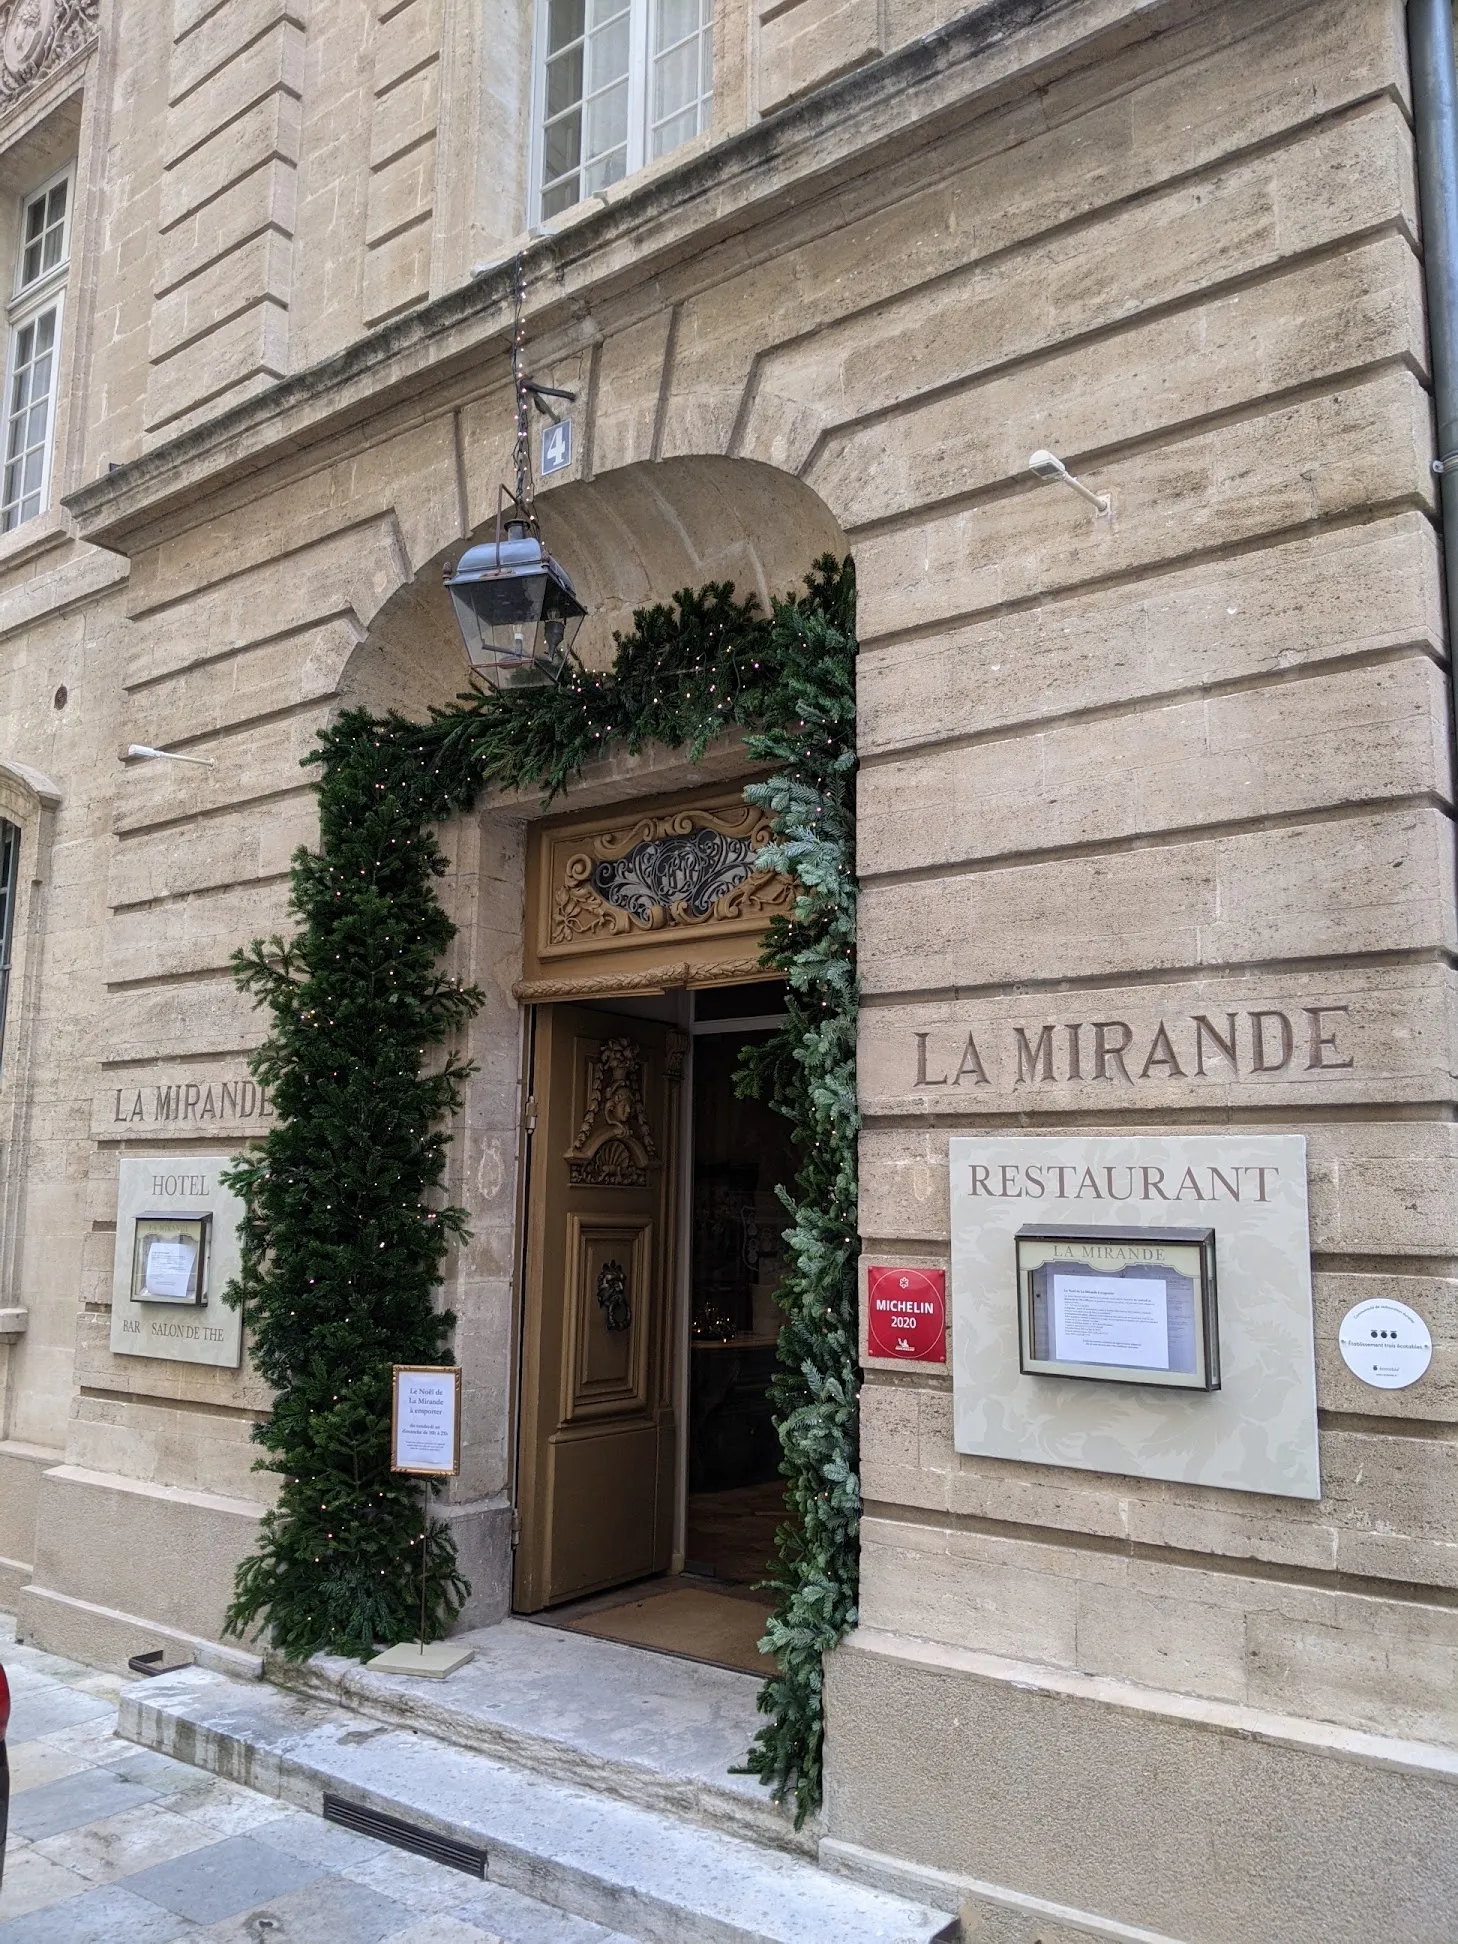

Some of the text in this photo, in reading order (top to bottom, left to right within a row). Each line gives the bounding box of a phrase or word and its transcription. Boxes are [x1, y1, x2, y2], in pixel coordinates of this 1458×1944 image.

[547, 427, 566, 466] 4
[912, 1005, 1354, 1087] LA MIRANDE
[113, 1080, 274, 1122] LA MIRANDE
[151, 1175, 210, 1197] HOTEL
[968, 1164, 1279, 1202] RESTAURANT
[1053, 1245, 1166, 1262] LA MIRANDE
[876, 1299, 934, 1314] MICHELIN
[123, 1319, 225, 1342] BAR SALON DE THE
[891, 1316, 917, 1329] 2020
[419, 1388, 434, 1396] Noël
[415, 1408, 442, 1416] emporter
